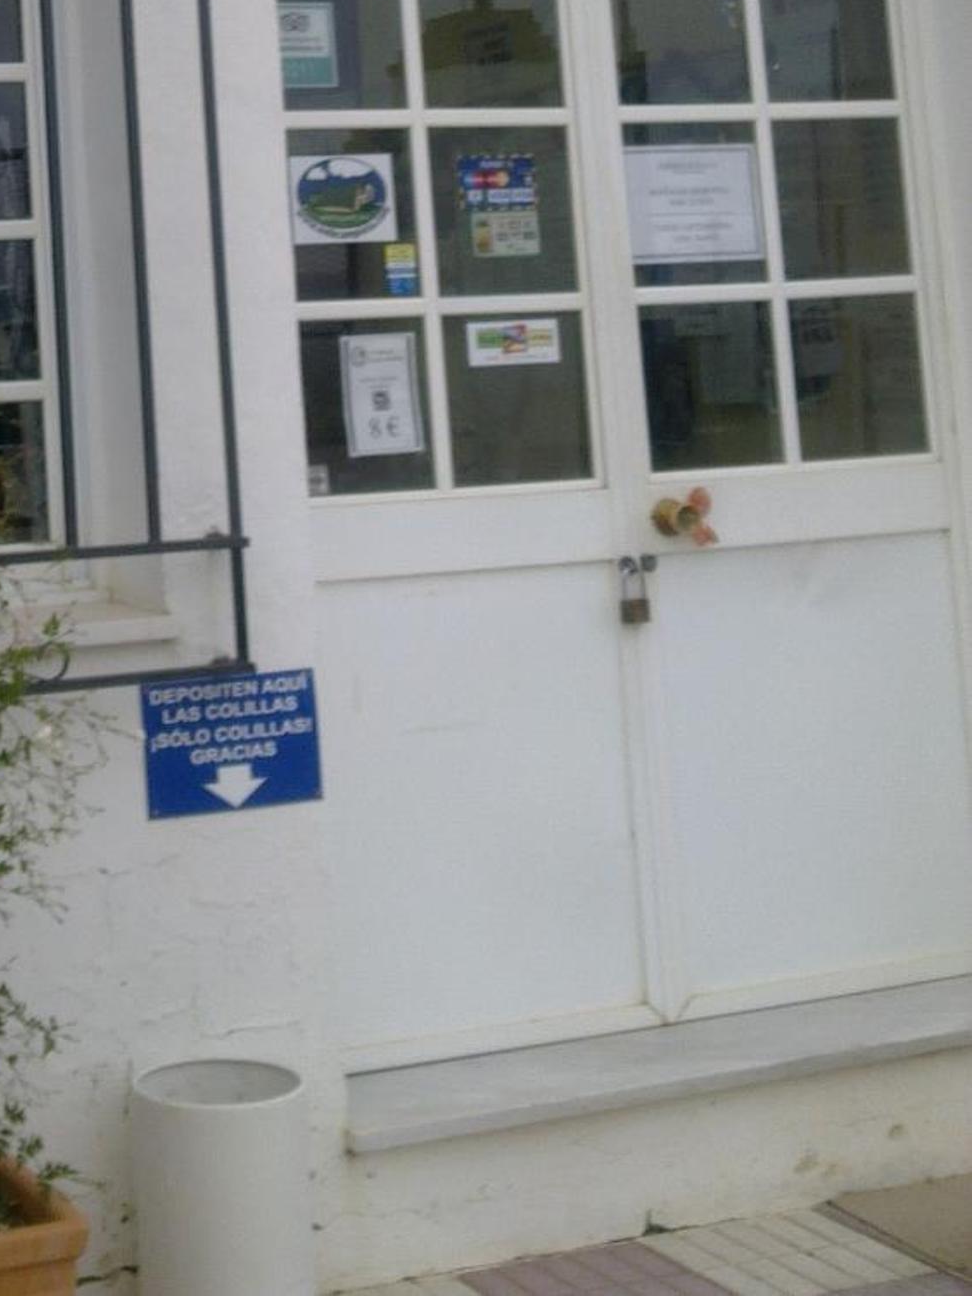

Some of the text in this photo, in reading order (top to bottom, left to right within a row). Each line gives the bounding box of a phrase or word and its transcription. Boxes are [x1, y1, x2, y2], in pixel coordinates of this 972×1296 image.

[149, 681, 259, 706] DEPOSITEN
[161, 696, 298, 724] LAS COLILLAS
[189, 740, 277, 765] GRACIAS
